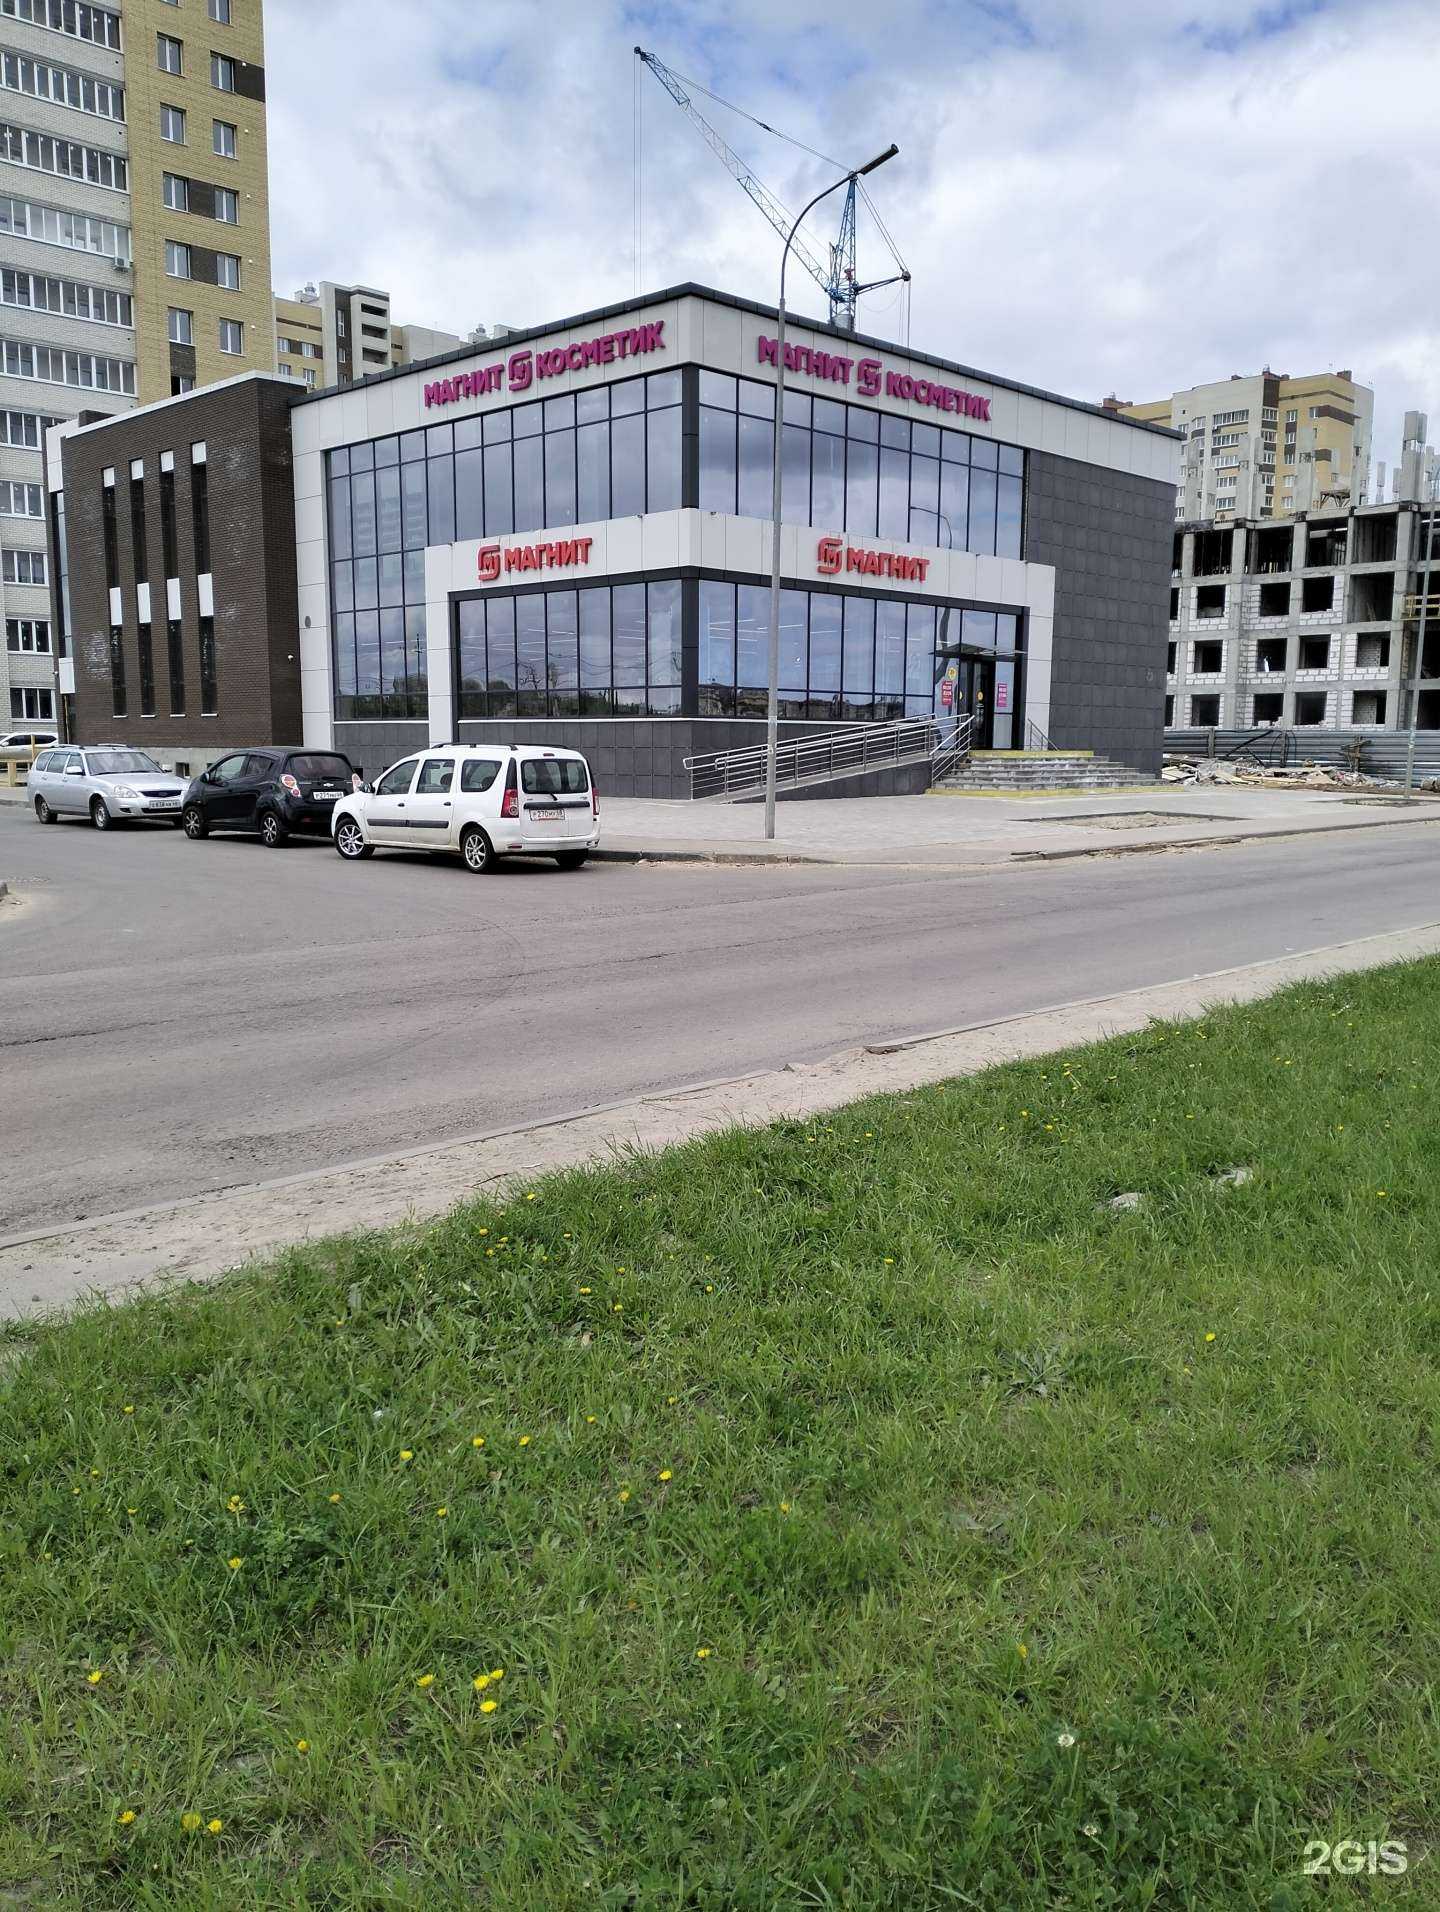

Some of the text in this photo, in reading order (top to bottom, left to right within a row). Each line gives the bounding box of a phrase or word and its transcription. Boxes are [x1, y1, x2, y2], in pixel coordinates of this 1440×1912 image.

[424, 320, 666, 408] МАГНИТ КОСМЕТИК
[758, 335, 991, 421] МАГНИТ КОСМЕТИК
[504, 537, 592, 572] МАГНИТ
[847, 547, 930, 583] МАГНИТ
